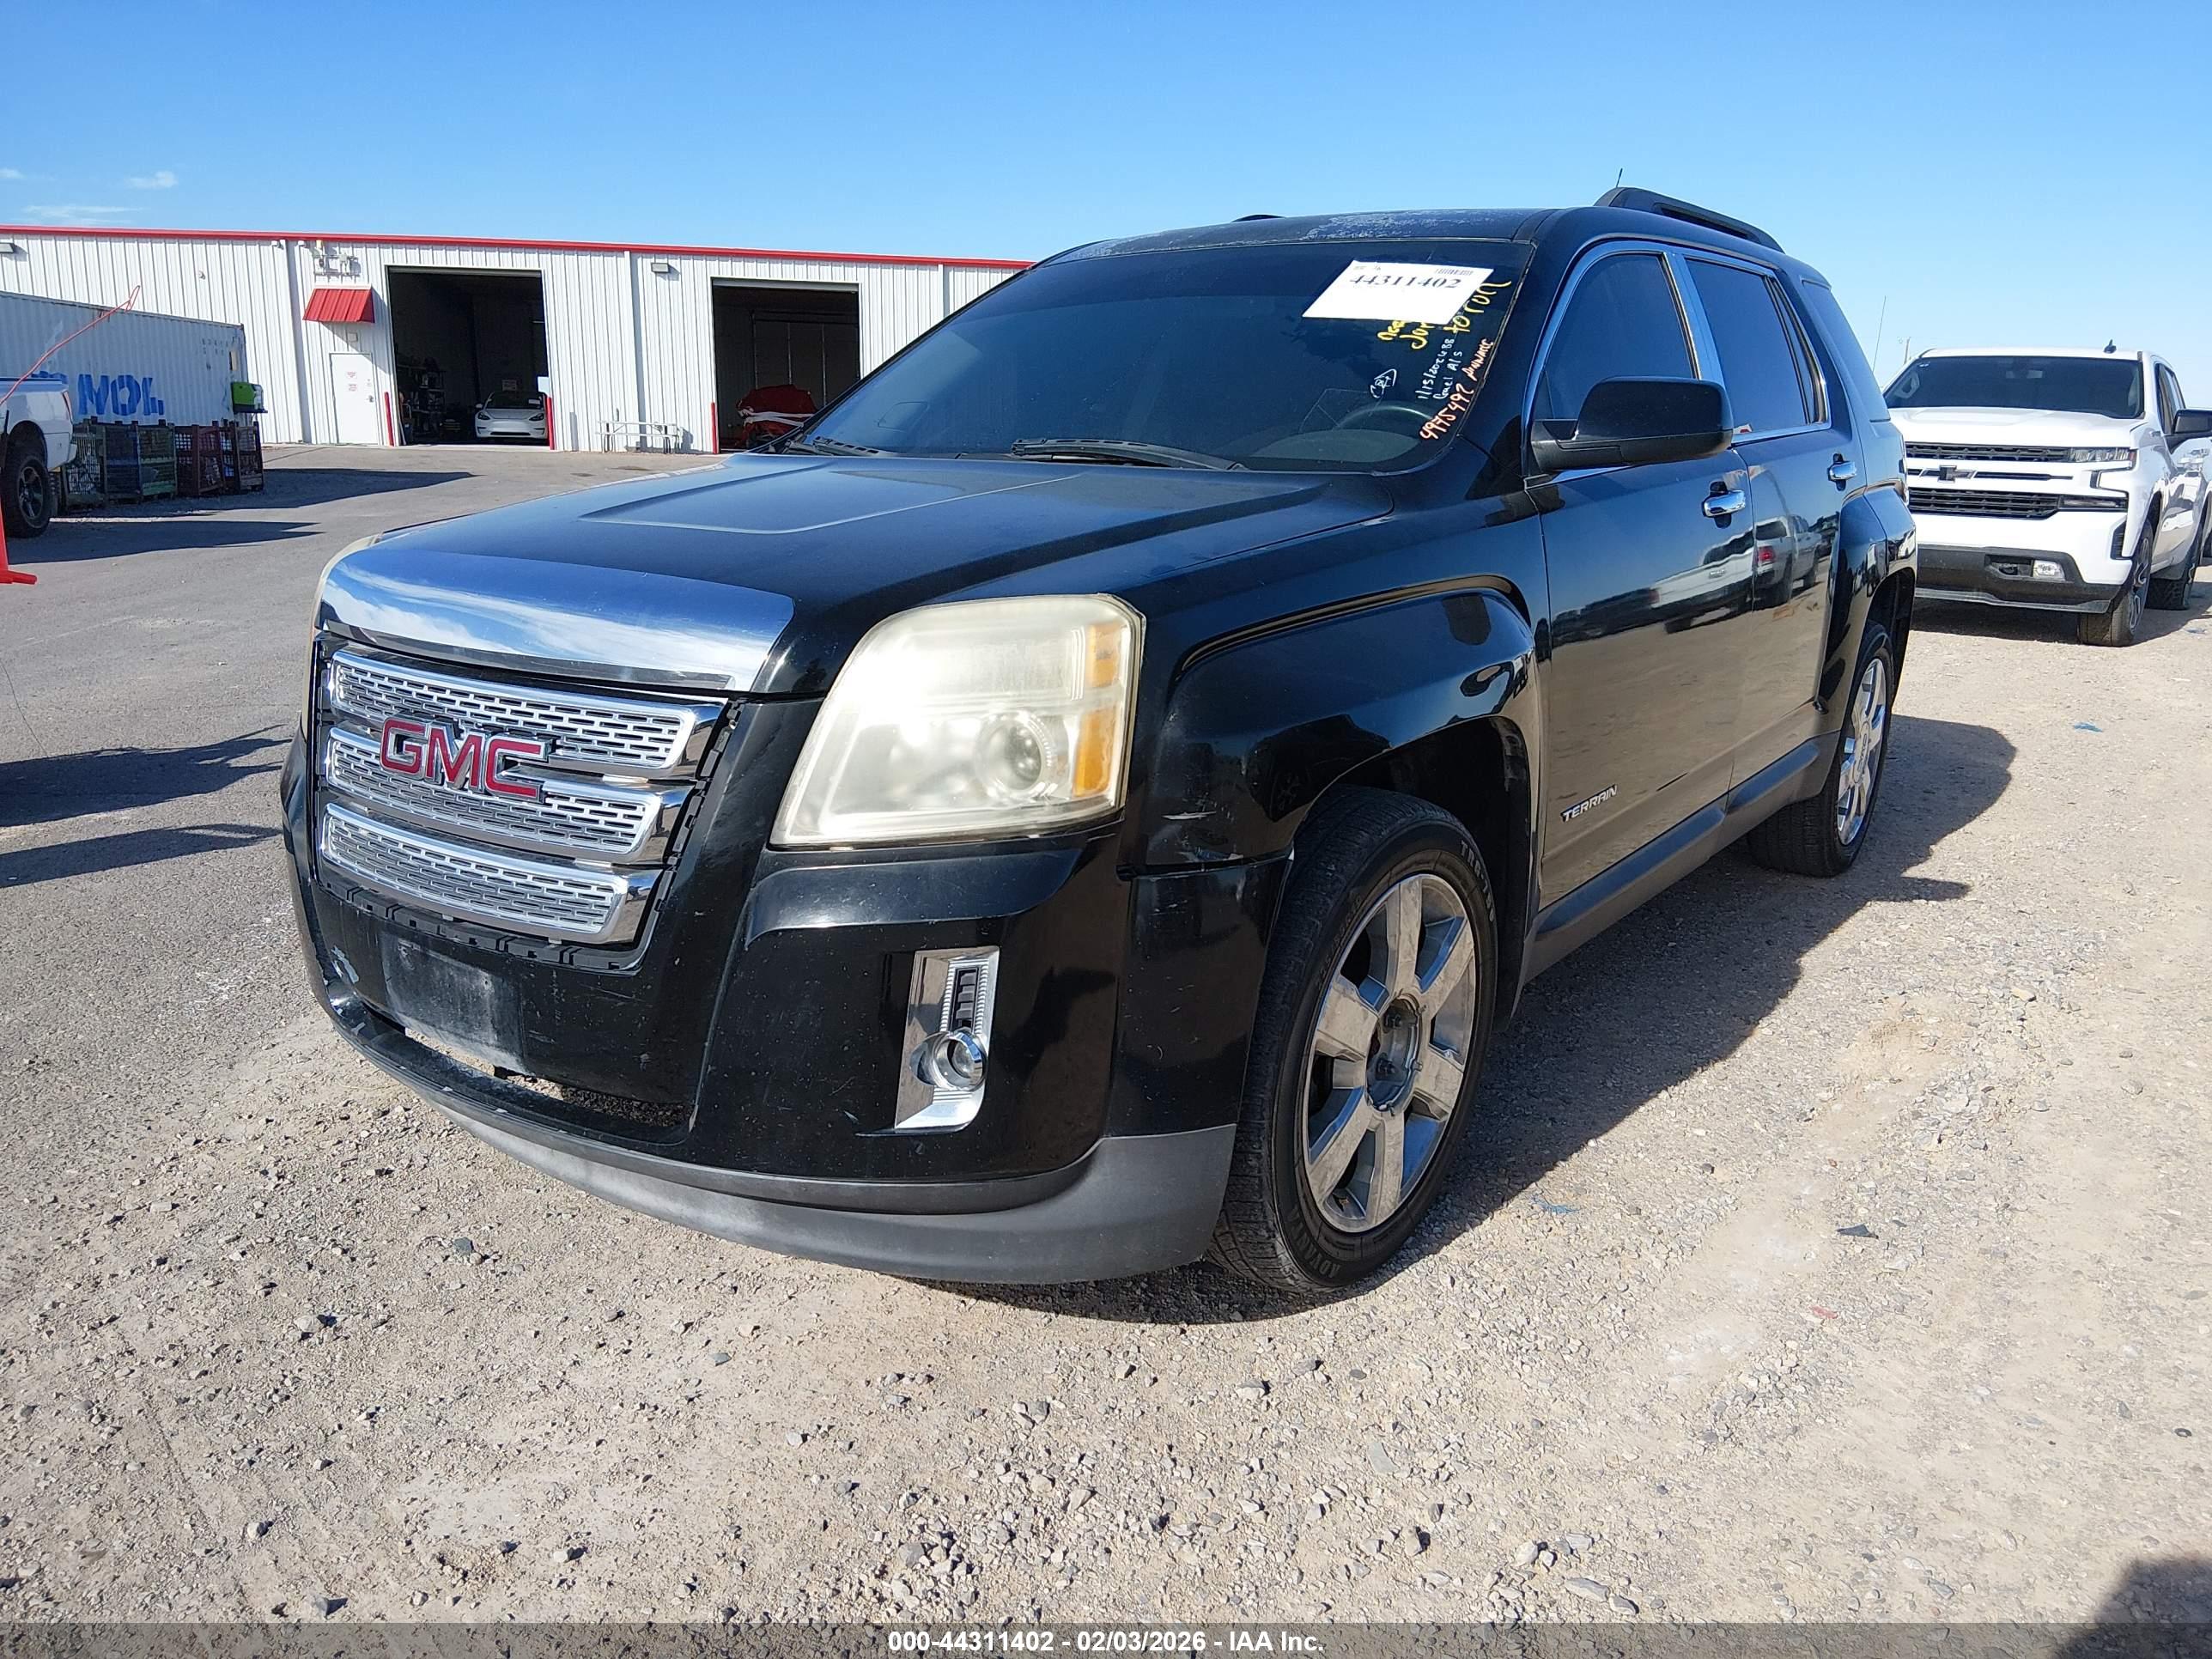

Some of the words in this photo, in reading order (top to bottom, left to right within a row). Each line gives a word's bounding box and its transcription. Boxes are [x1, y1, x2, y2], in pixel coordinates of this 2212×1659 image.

[1350, 274, 1462, 289] 44311402
[1443, 314, 1470, 333] to
[380, 715, 550, 804] GMC
[1561, 785, 1618, 822] TERRAIN
